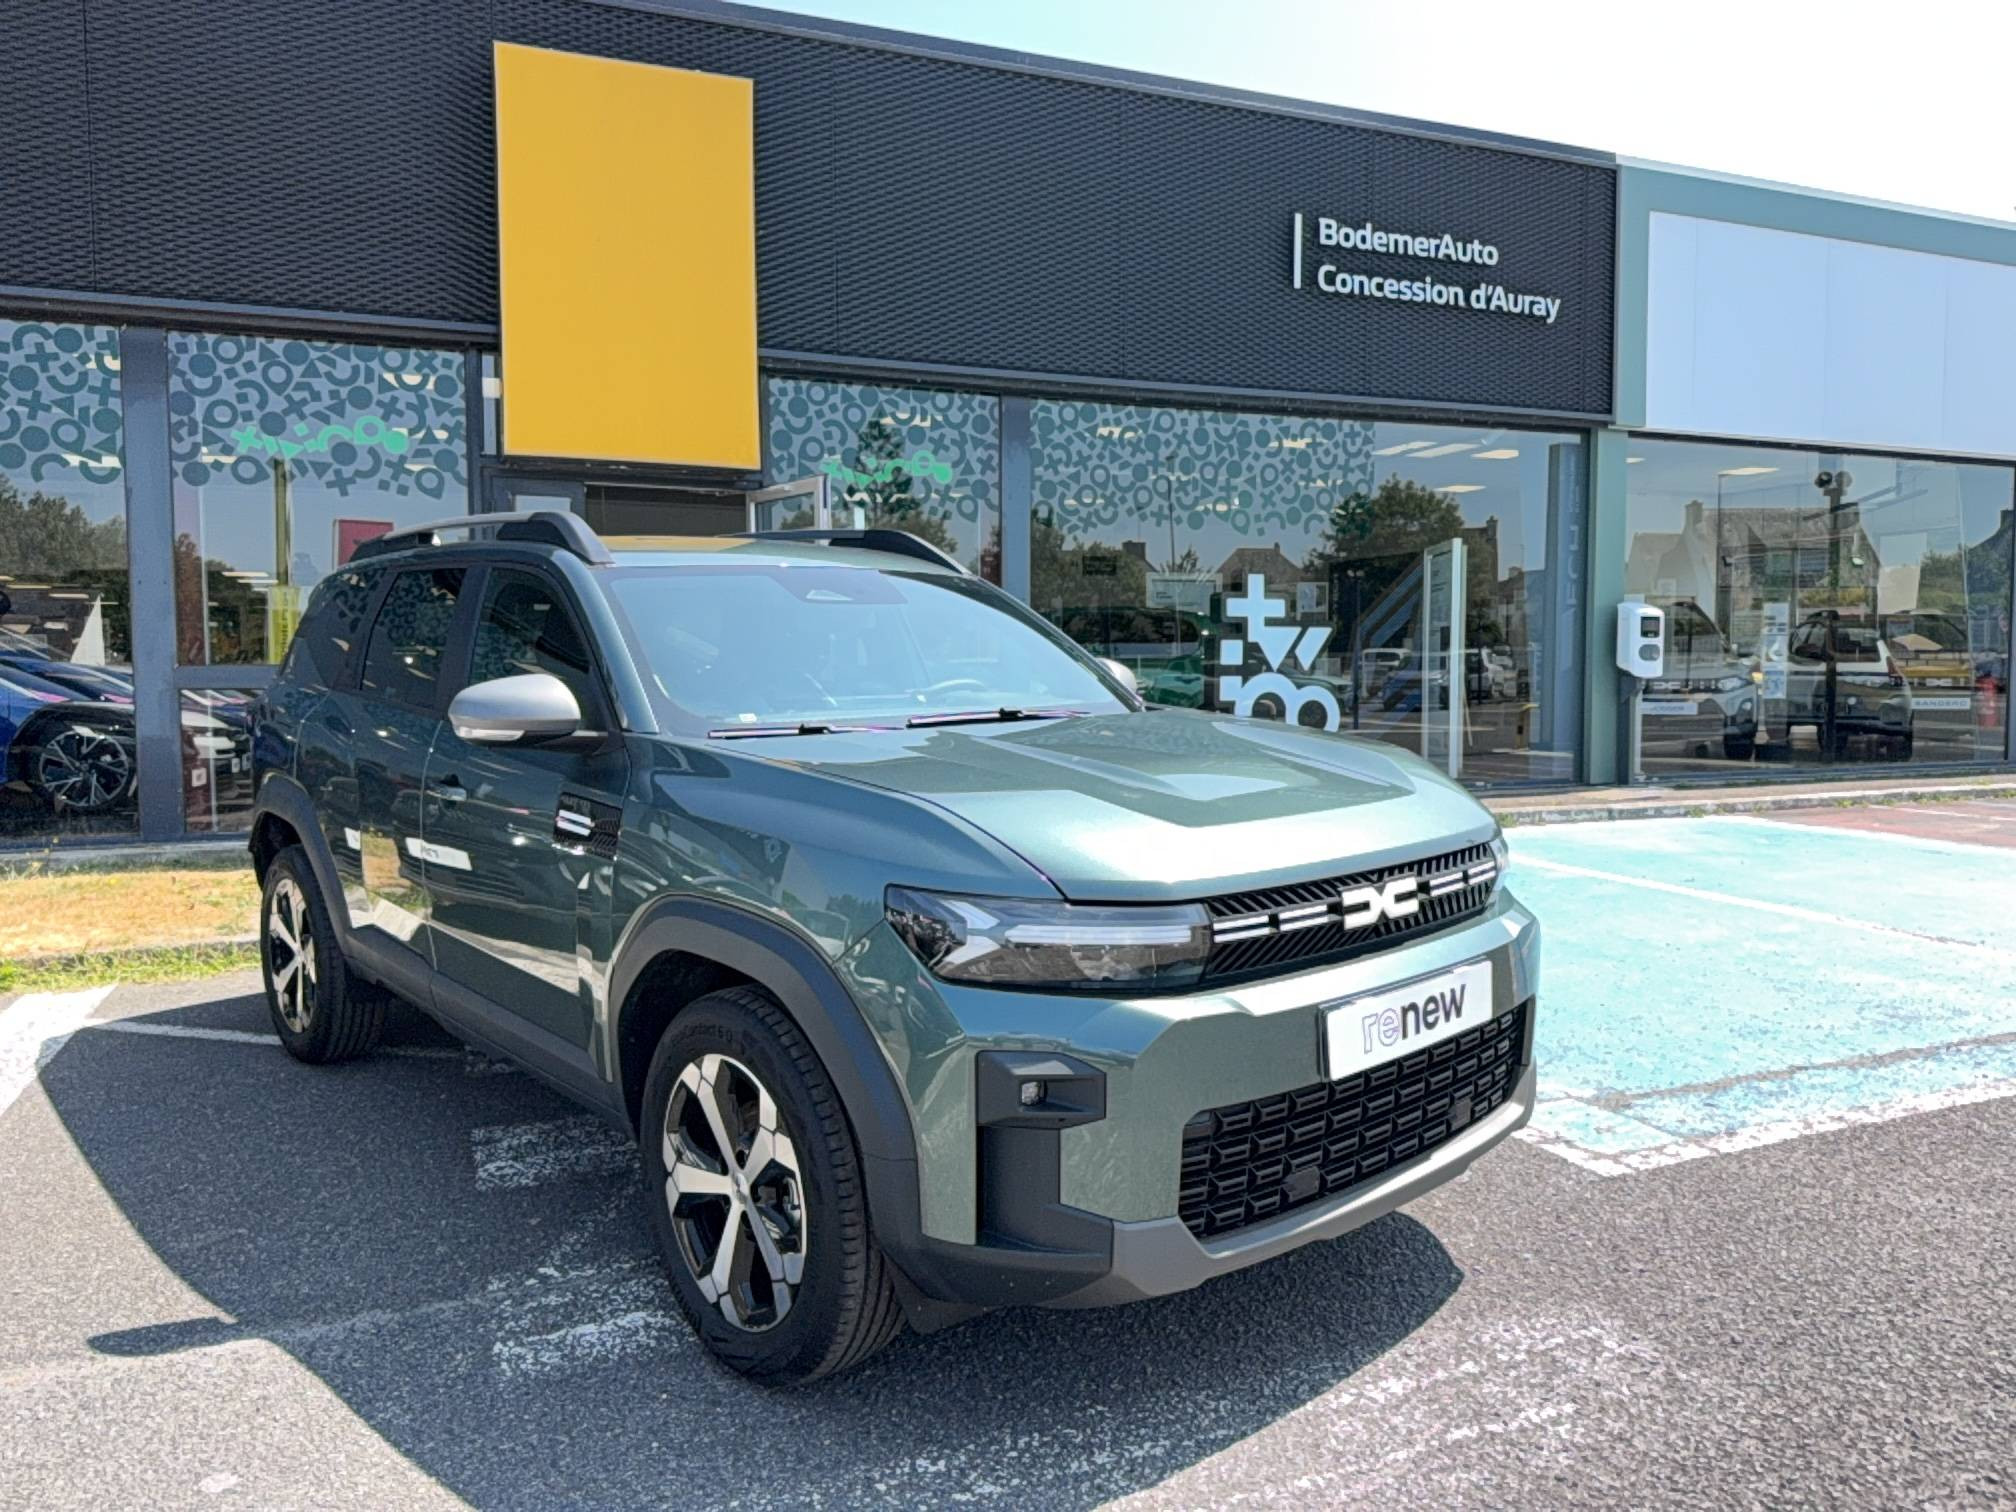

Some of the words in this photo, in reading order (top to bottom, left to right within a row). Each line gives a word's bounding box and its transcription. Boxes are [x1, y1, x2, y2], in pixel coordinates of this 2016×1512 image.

[1318, 217, 1499, 265] BodemerAuto
[1317, 265, 1466, 307] Concession
[1470, 283, 1561, 323] d'Auray
[1362, 984, 1466, 1054] renew
